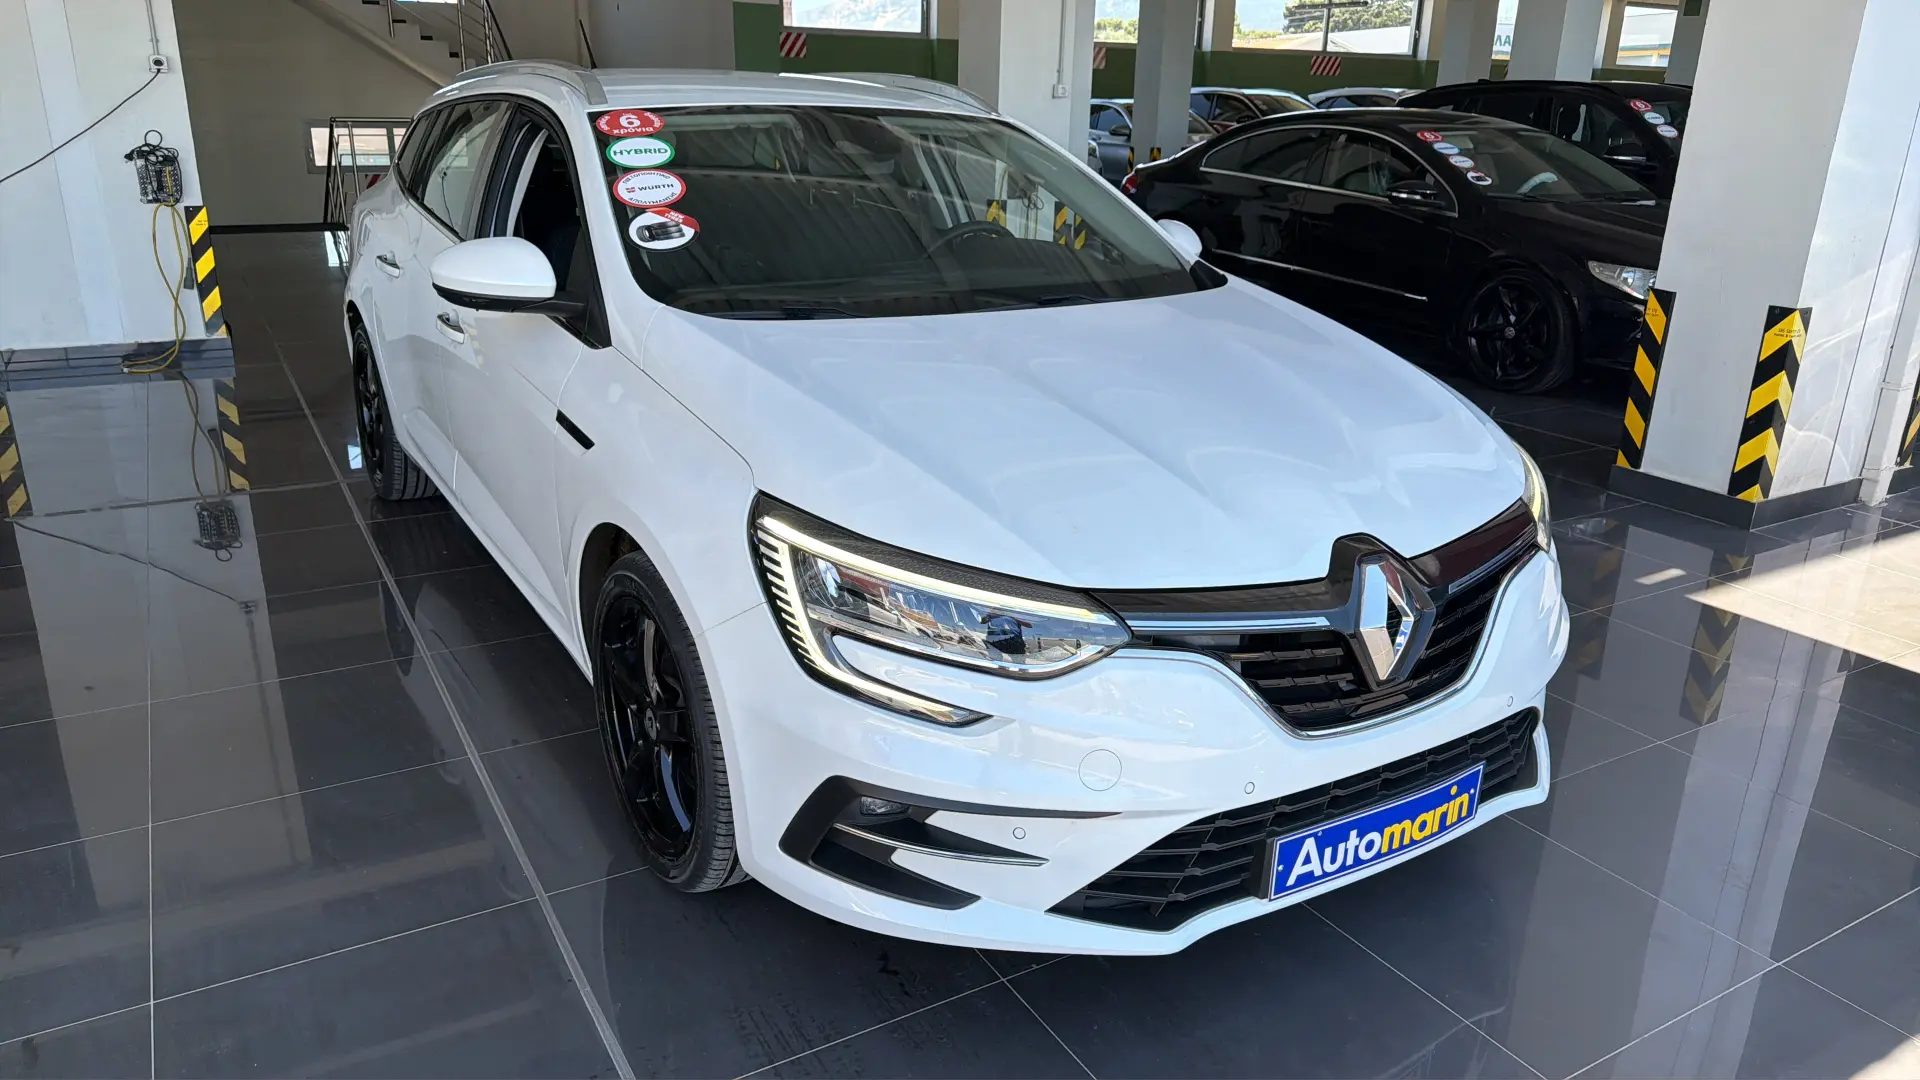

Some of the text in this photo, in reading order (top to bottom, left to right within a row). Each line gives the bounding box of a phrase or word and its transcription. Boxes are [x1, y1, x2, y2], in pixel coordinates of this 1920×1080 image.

[619, 114, 641, 128] 6
[612, 126, 654, 135] χρόνια
[612, 147, 668, 157] HYBRID
[1285, 784, 1471, 887] Automarin
